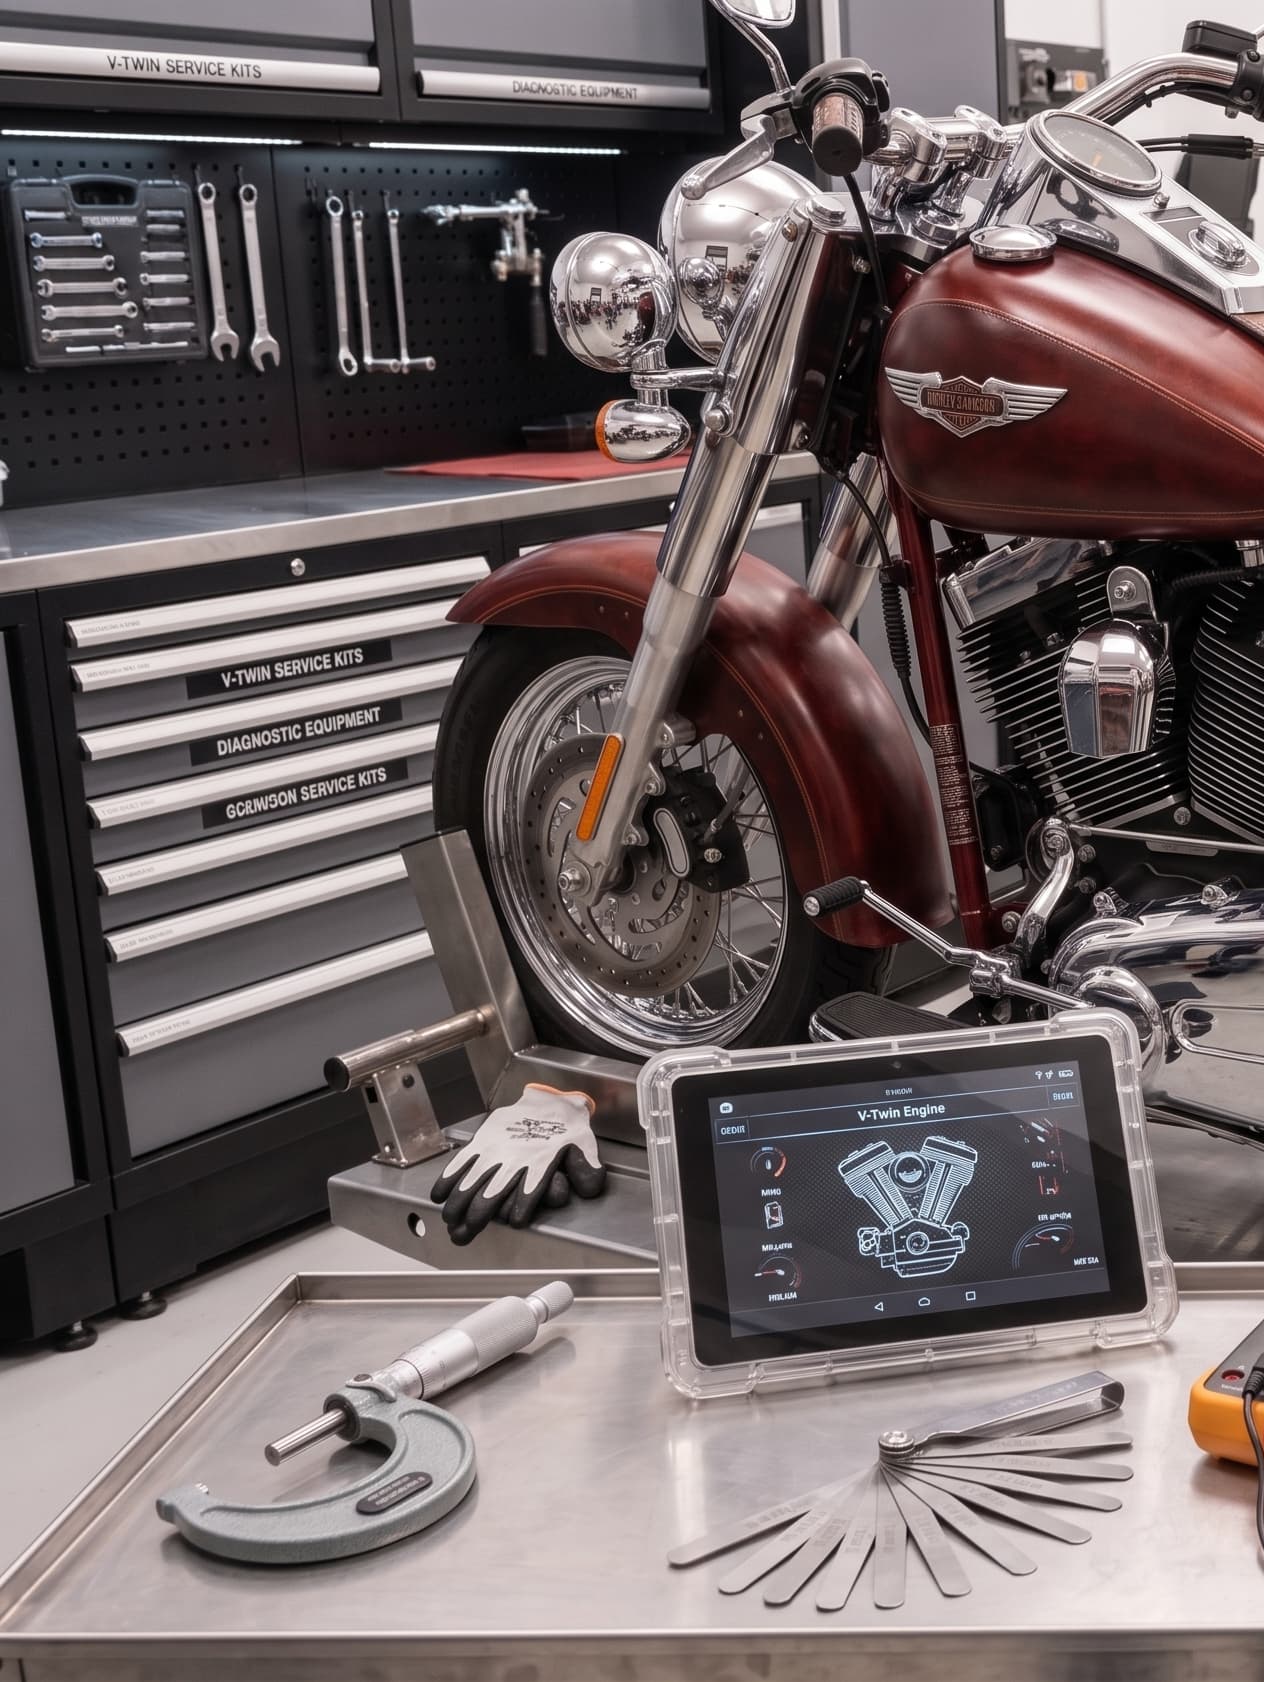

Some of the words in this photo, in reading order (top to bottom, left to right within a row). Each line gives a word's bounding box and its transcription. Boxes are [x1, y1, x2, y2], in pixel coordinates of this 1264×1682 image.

[107, 55, 160, 72] V-TWIN
[166, 59, 226, 77] SERVICE
[230, 63, 262, 79] KITS
[221, 664, 272, 688] V-TWIN
[274, 653, 332, 679] SERVICE
[334, 647, 364, 667] KITS
[216, 724, 302, 756] DIAGNOSTIC
[305, 706, 381, 737] EQUIPMENT
[300, 774, 357, 801] SERVICE
[358, 767, 387, 787] KITS
[857, 1108, 901, 1122] V-Twin
[903, 1102, 946, 1119] Engine
